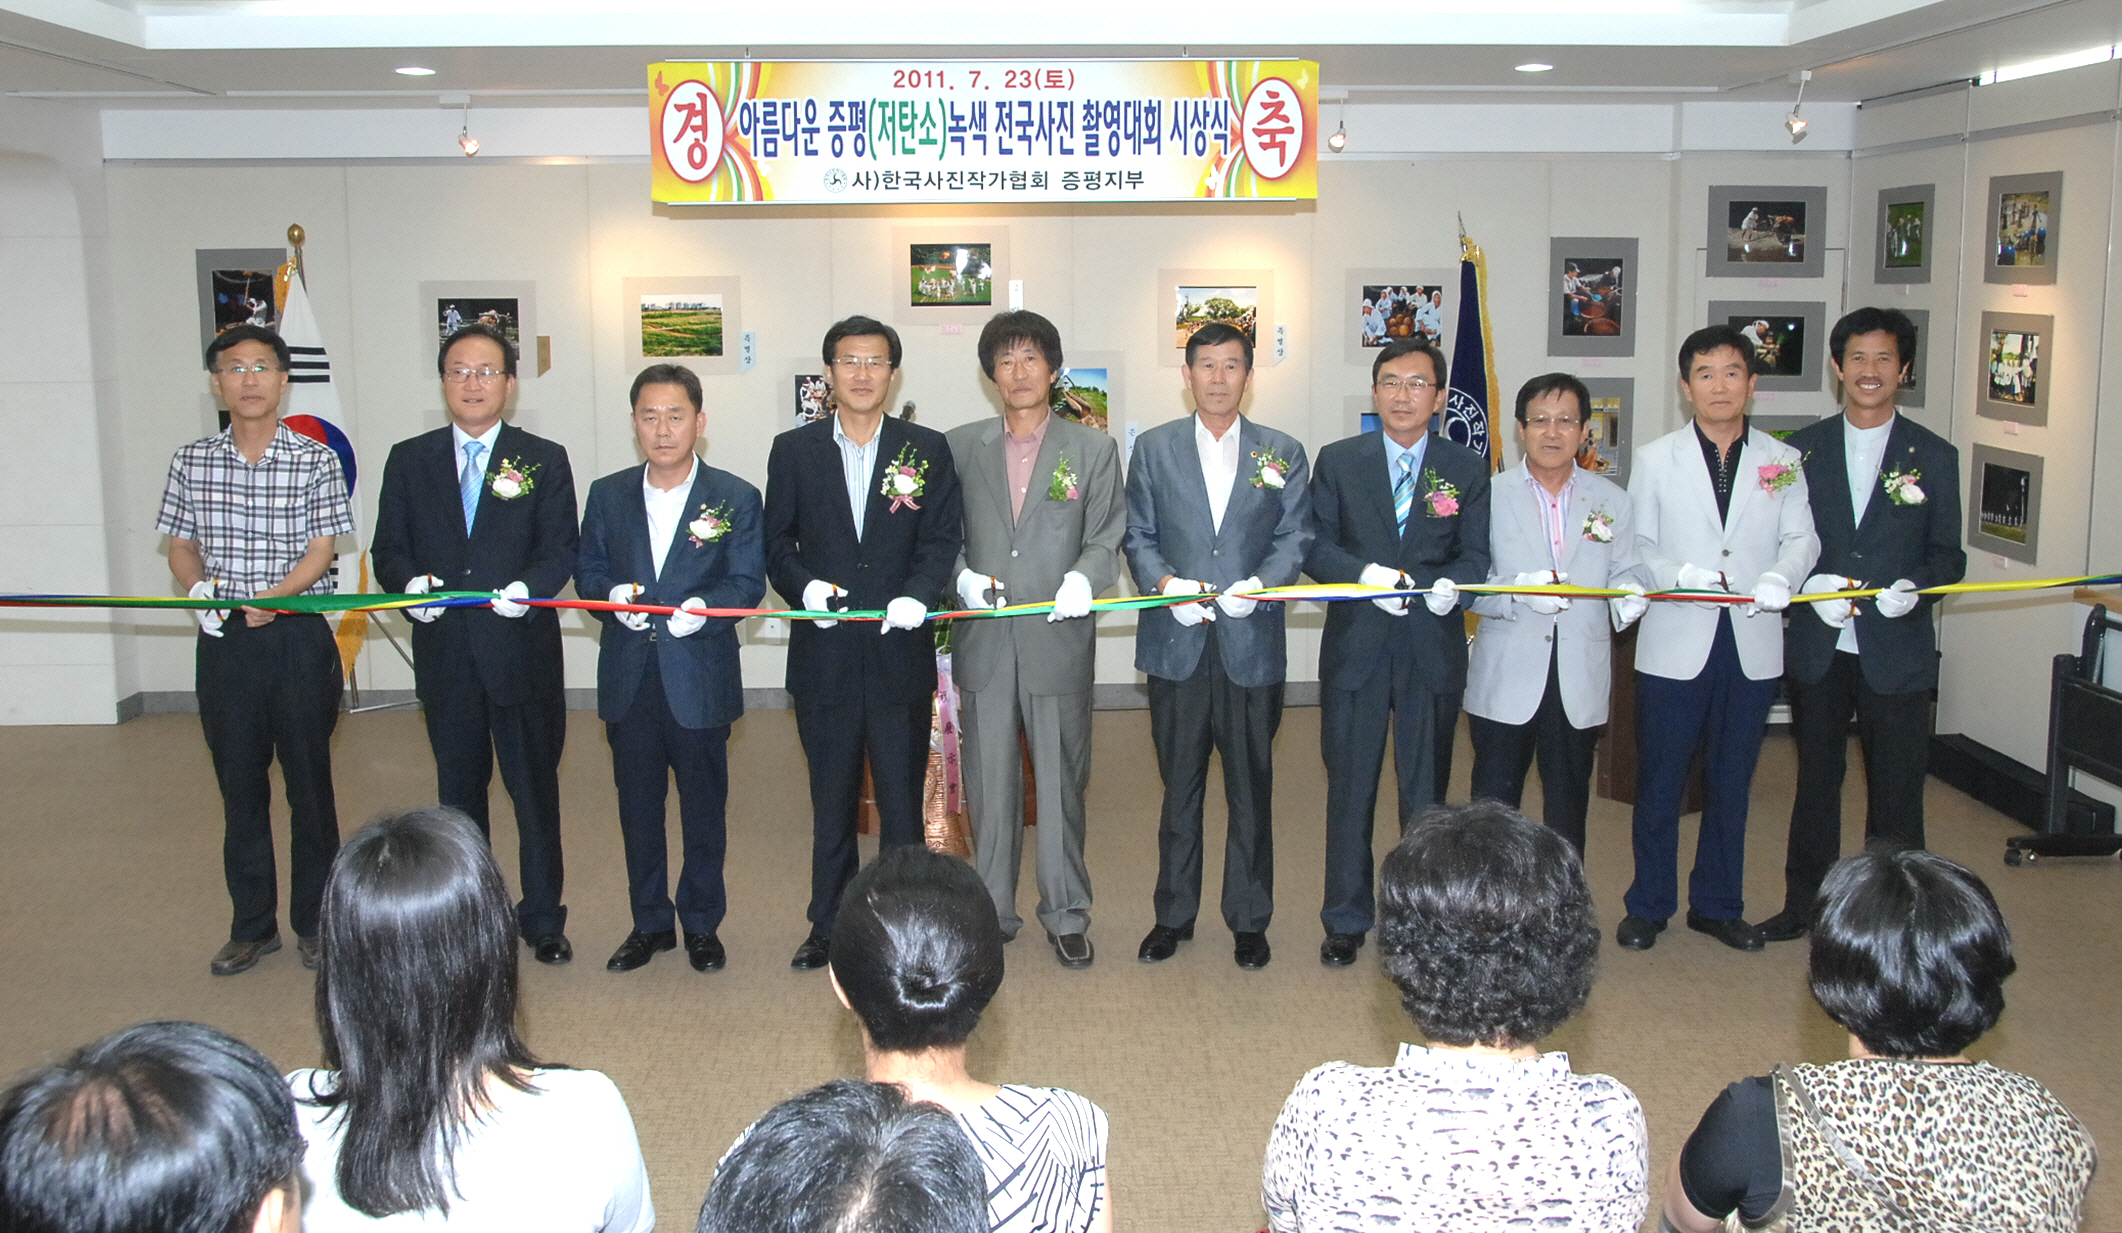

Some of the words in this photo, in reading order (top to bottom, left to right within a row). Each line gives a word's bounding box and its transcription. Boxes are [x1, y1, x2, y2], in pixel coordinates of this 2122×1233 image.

[893, 69, 955, 91] 2011.
[968, 70, 990, 91] 7.
[1004, 68, 1075, 91] 23(토)
[672, 91, 708, 170] 경
[739, 98, 821, 158] 아름다운
[827, 97, 987, 161] 증평(저탄소)녹색
[995, 100, 1074, 157] 전국사진
[1082, 98, 1162, 158] 촬영대회
[1169, 99, 1229, 158] 시상식
[1251, 89, 1296, 168] 축
[851, 170, 1049, 191] 사)한국사진작가협회
[1061, 169, 1145, 191] 증평지부
